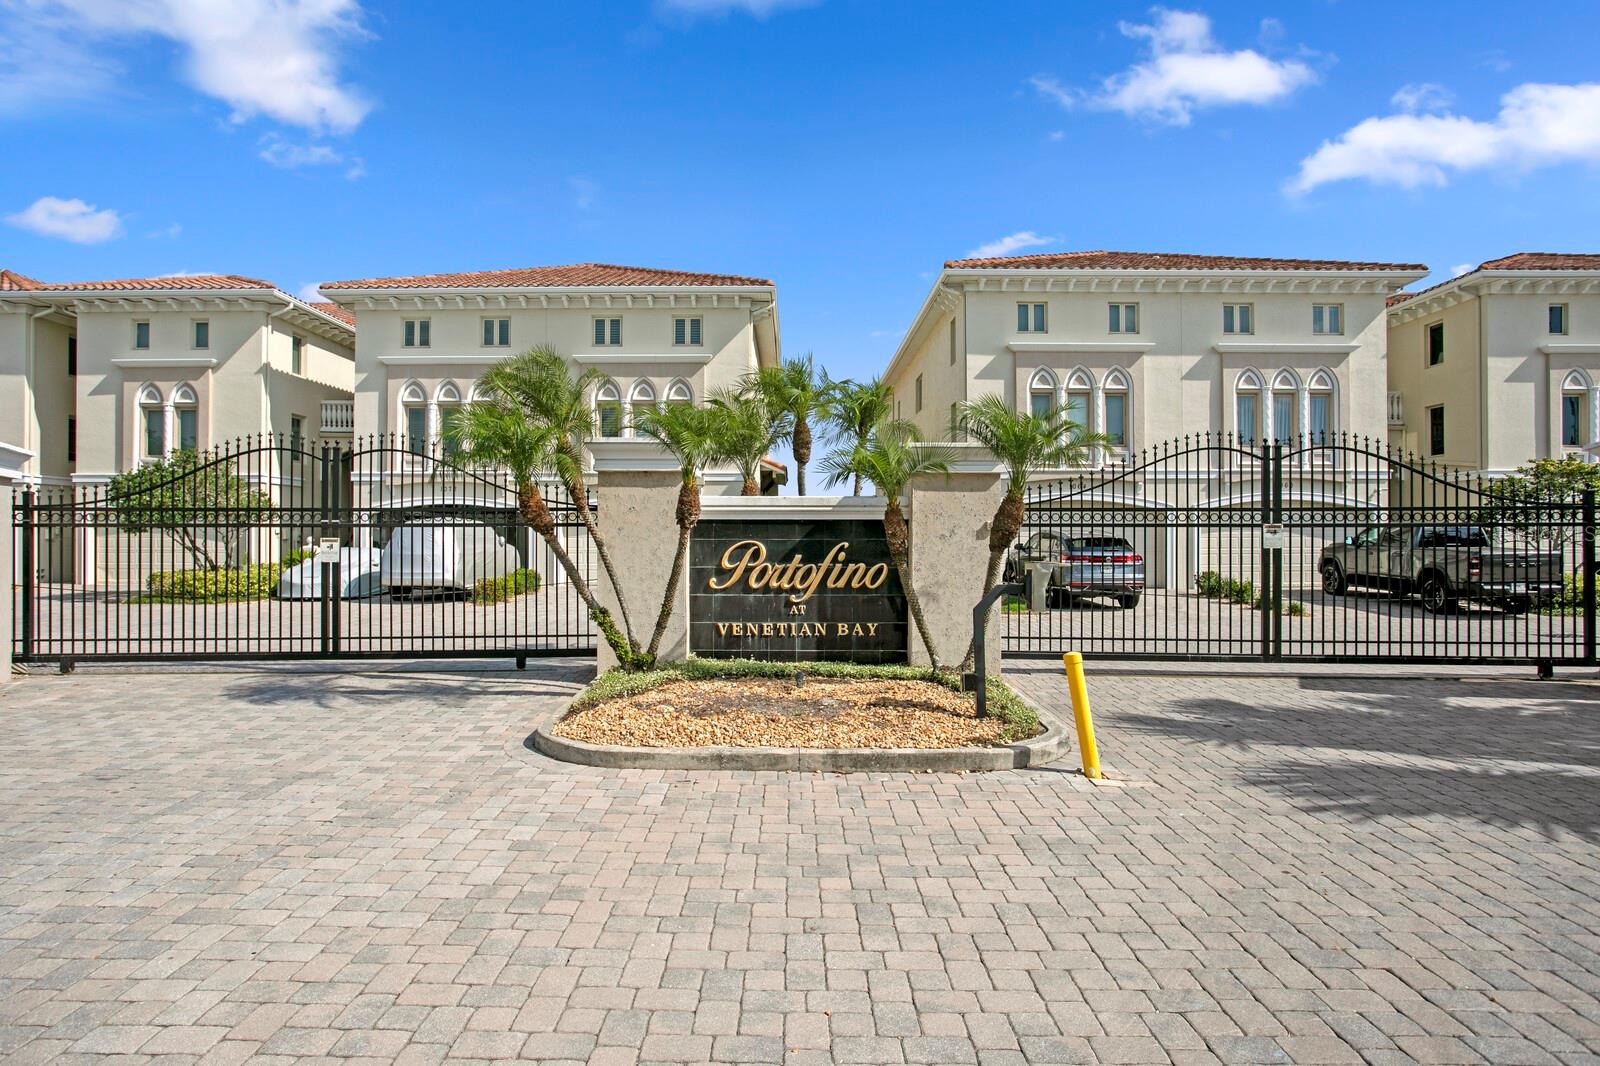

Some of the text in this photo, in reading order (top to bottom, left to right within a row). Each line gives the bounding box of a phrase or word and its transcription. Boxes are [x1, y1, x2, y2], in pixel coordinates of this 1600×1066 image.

[708, 540, 888, 602] Portofino
[789, 605, 807, 615] AT
[717, 623, 879, 637] VENETIAN BAY
